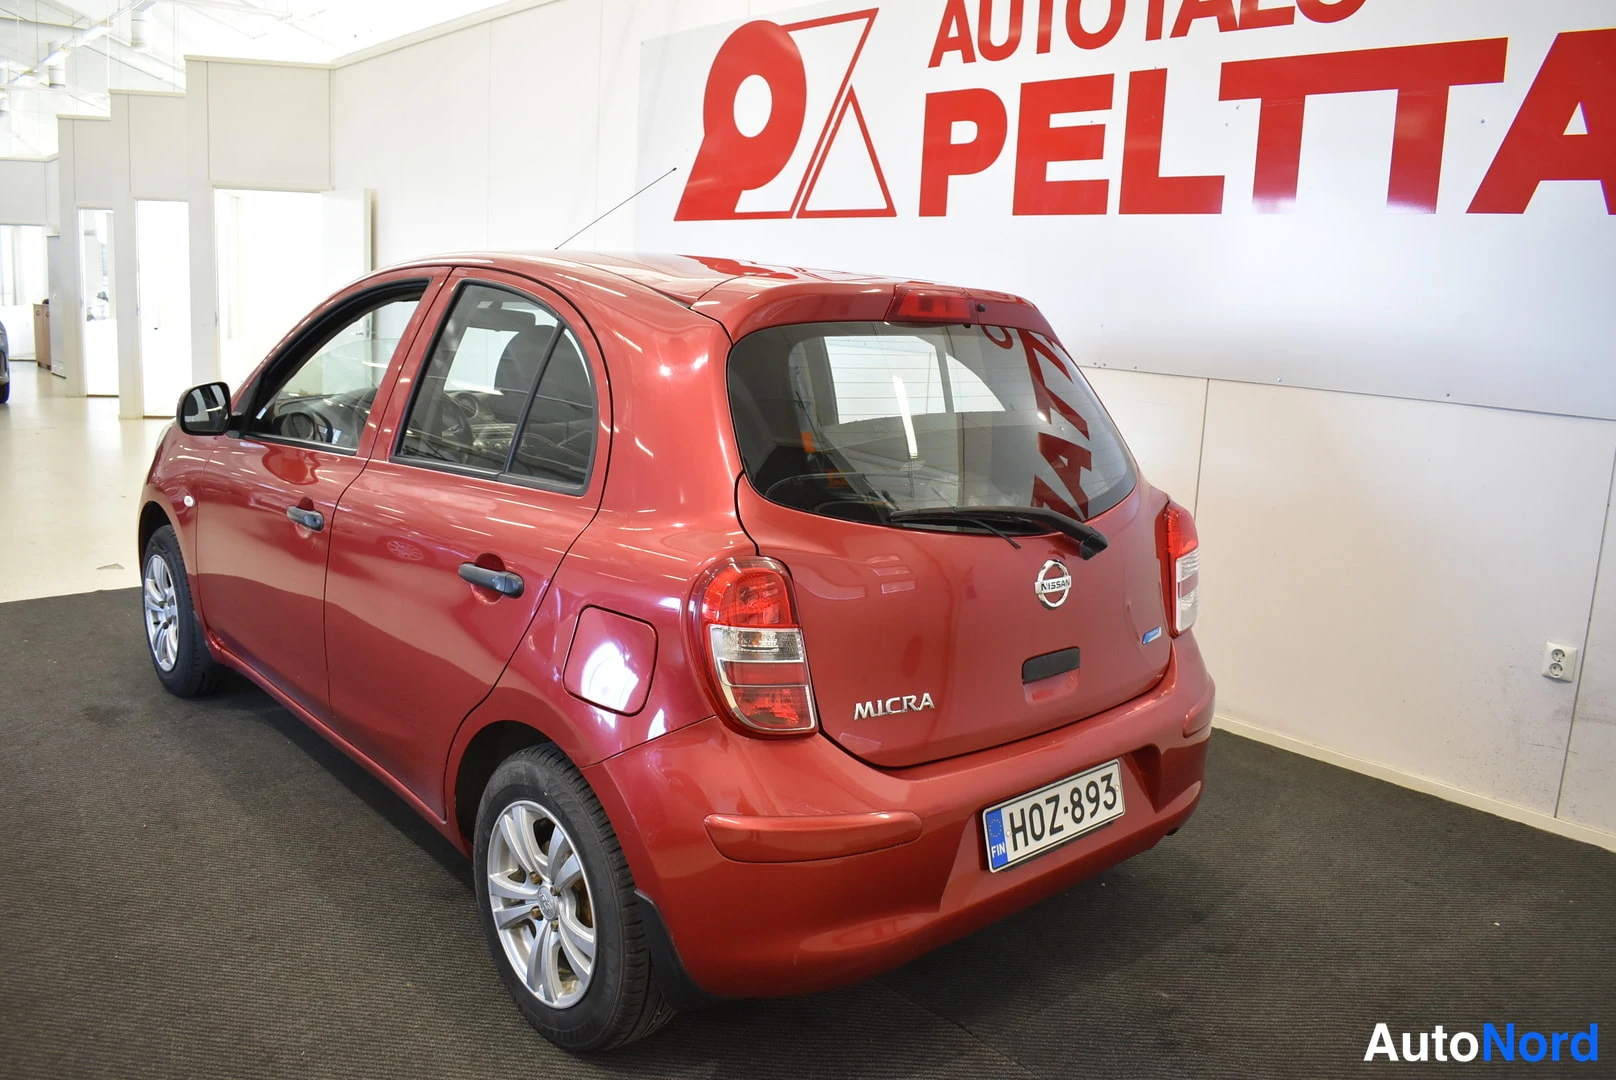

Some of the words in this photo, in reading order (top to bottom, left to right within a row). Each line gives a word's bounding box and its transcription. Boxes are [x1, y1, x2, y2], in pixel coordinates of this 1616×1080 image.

[928, 0, 1367, 68] AUTO
[919, 28, 1616, 218] PELTTA
[1040, 579, 1070, 591] NISSAN
[853, 692, 935, 721] MICRA
[991, 842, 1007, 859] FIN
[1009, 772, 1118, 852] HOZ-893
